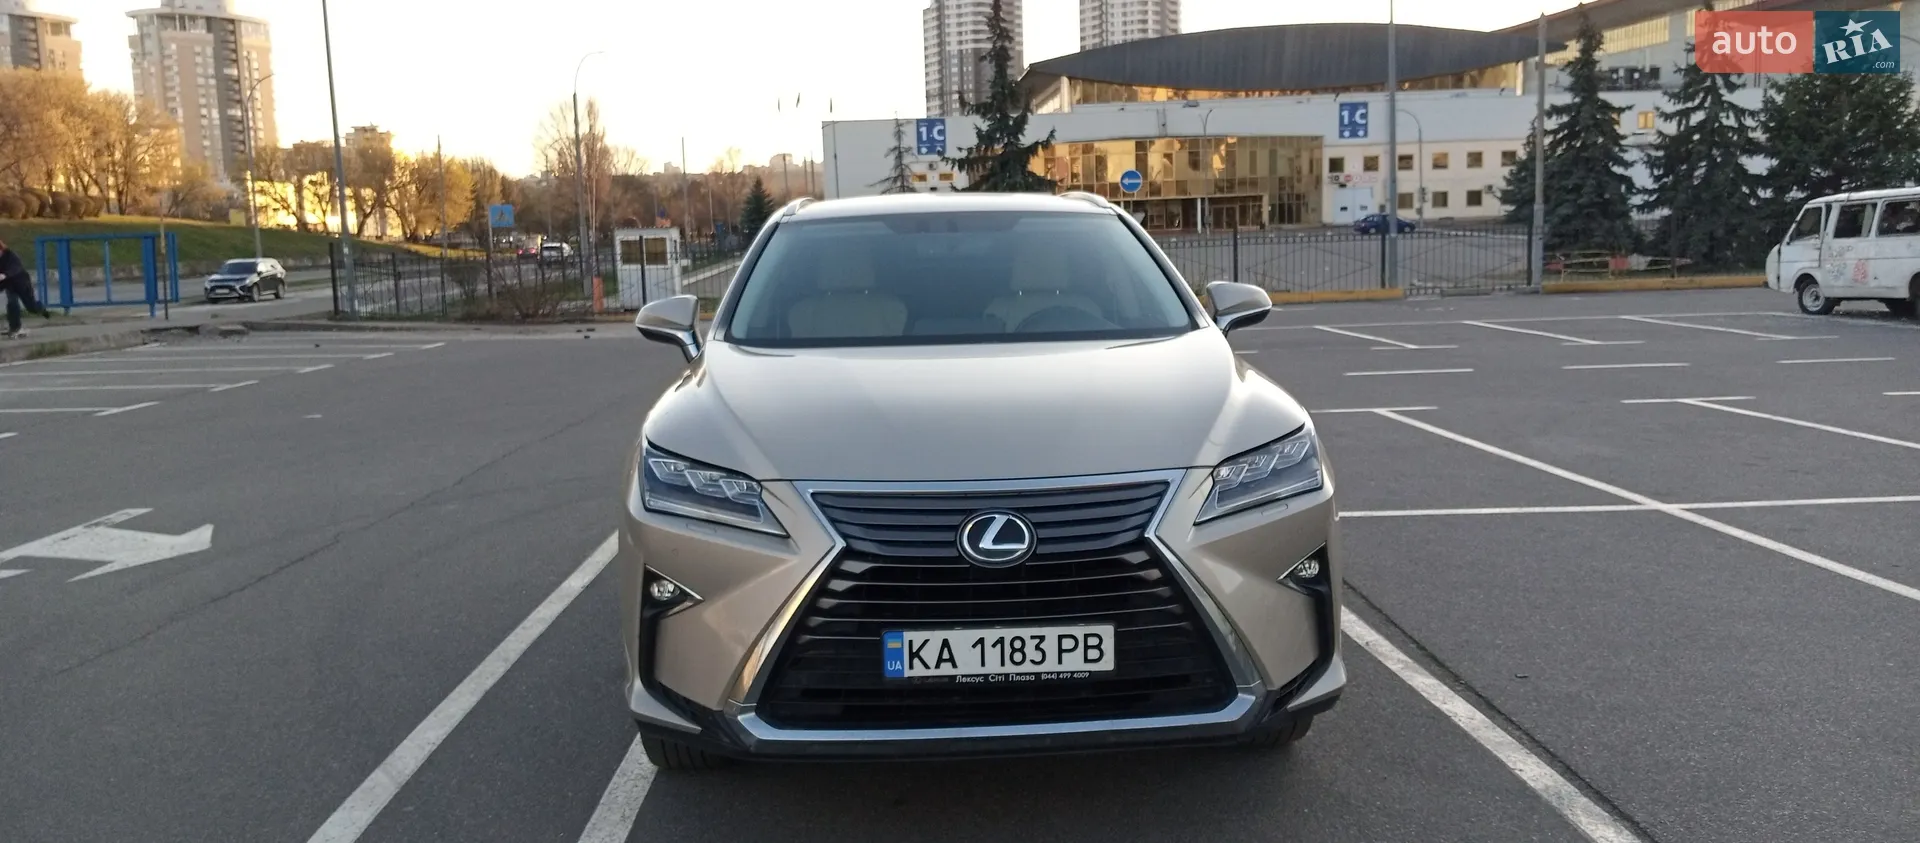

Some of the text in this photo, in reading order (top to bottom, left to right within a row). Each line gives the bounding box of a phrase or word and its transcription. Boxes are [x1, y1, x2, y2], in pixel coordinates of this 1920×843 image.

[908, 632, 1105, 670] KA 1183 PB
[887, 661, 903, 671] UA
[955, 675, 985, 684] Лексус
[988, 674, 1005, 682] Сіті
[1009, 673, 1035, 681] Плаза
